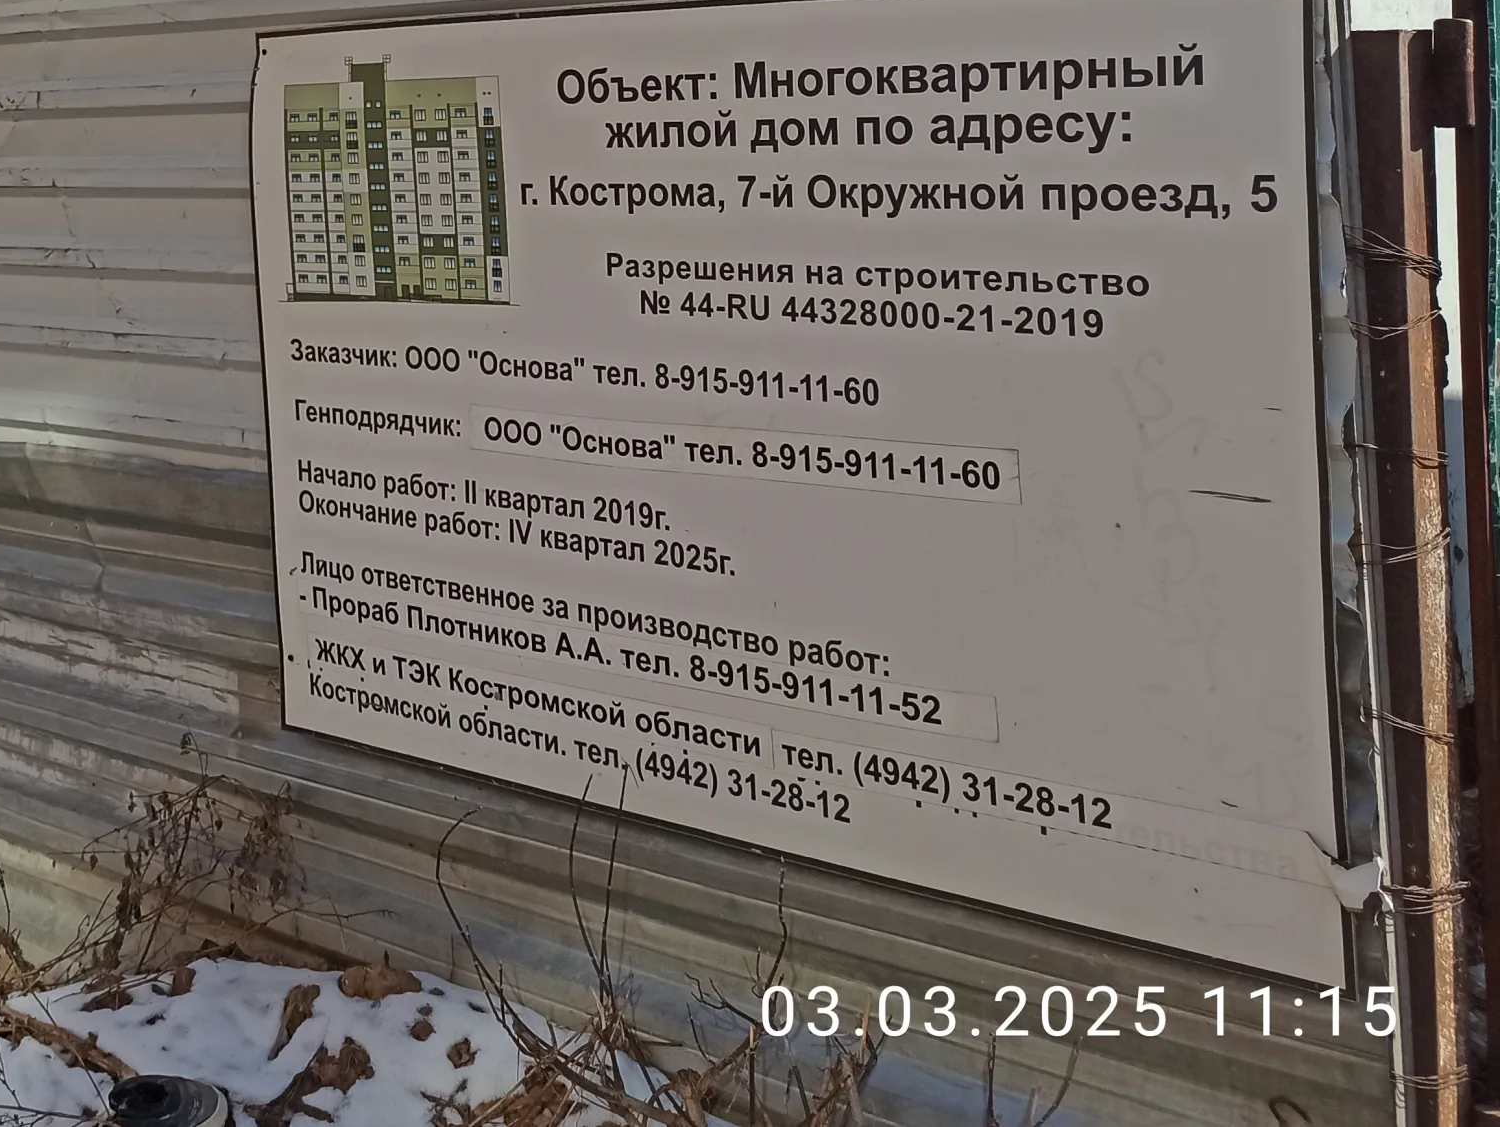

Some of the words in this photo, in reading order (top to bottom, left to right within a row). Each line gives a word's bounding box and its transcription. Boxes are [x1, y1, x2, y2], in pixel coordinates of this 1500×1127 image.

[557, 67, 718, 104] Объект:
[734, 43, 1204, 103] Многоквартирный
[605, 109, 737, 149] жилой
[750, 117, 839, 153] дом
[856, 115, 913, 146] по
[930, 111, 1132, 154] адресу:
[520, 183, 538, 205] г.
[550, 175, 725, 214] Кострома,
[737, 174, 793, 208] 7-й
[807, 174, 1024, 219] Окружной
[1041, 183, 1231, 220] проезд,
[1250, 174, 1278, 213] 5
[606, 252, 794, 284] Разрешения
[806, 265, 843, 285] на
[855, 265, 1150, 297] строительство
[640, 290, 670, 315] №
[680, 291, 770, 321] 44-RU
[782, 295, 1104, 338] 44328000-21-2019
[290, 339, 397, 368] Заказчик:
[405, 345, 460, 372] ООО
[468, 349, 585, 382] "Основа"
[593, 364, 646, 387] тел.
[655, 363, 880, 406] 8-915-911-11-60
[294, 399, 461, 437] Генподрядчик:
[484, 417, 542, 446] ООО
[550, 424, 675, 461] "Основа"
[684, 441, 742, 466] тел.
[752, 441, 1001, 490] 8-915-911-11-60
[297, 459, 376, 491] Начало
[383, 473, 456, 502] работ:
[485, 487, 585, 519] квартал
[593, 496, 671, 531] 2019г.
[298, 490, 417, 528] Окончание
[424, 511, 500, 541] работ:
[509, 518, 532, 546] IV
[540, 527, 645, 562] квартал
[654, 539, 735, 576] 2025г.
[301, 551, 354, 584] Лицо
[361, 566, 535, 613] ответственное
[542, 596, 569, 619] за
[577, 602, 778, 657] производство
[789, 639, 890, 677] работ:
[312, 586, 399, 625] Прораб
[406, 605, 547, 653] Плотников
[555, 631, 612, 665] А.А.
[620, 648, 679, 678] тел.
[690, 654, 943, 725] 8-915-911-11-52
[309, 673, 451, 728] Костромской
[459, 711, 567, 756] области.
[574, 740, 627, 769] тел.
[635, 746, 718, 798] (4942)
[728, 768, 851, 823] 31-28-12
[315, 638, 365, 672] ЖКХ
[373, 656, 386, 676] и
[392, 655, 442, 688] ТЭК
[449, 667, 626, 728] Костромской
[635, 711, 761, 757] области
[781, 743, 842, 775] тел.
[854, 750, 950, 803] (4942)
[962, 772, 1113, 830] 31-28-12
